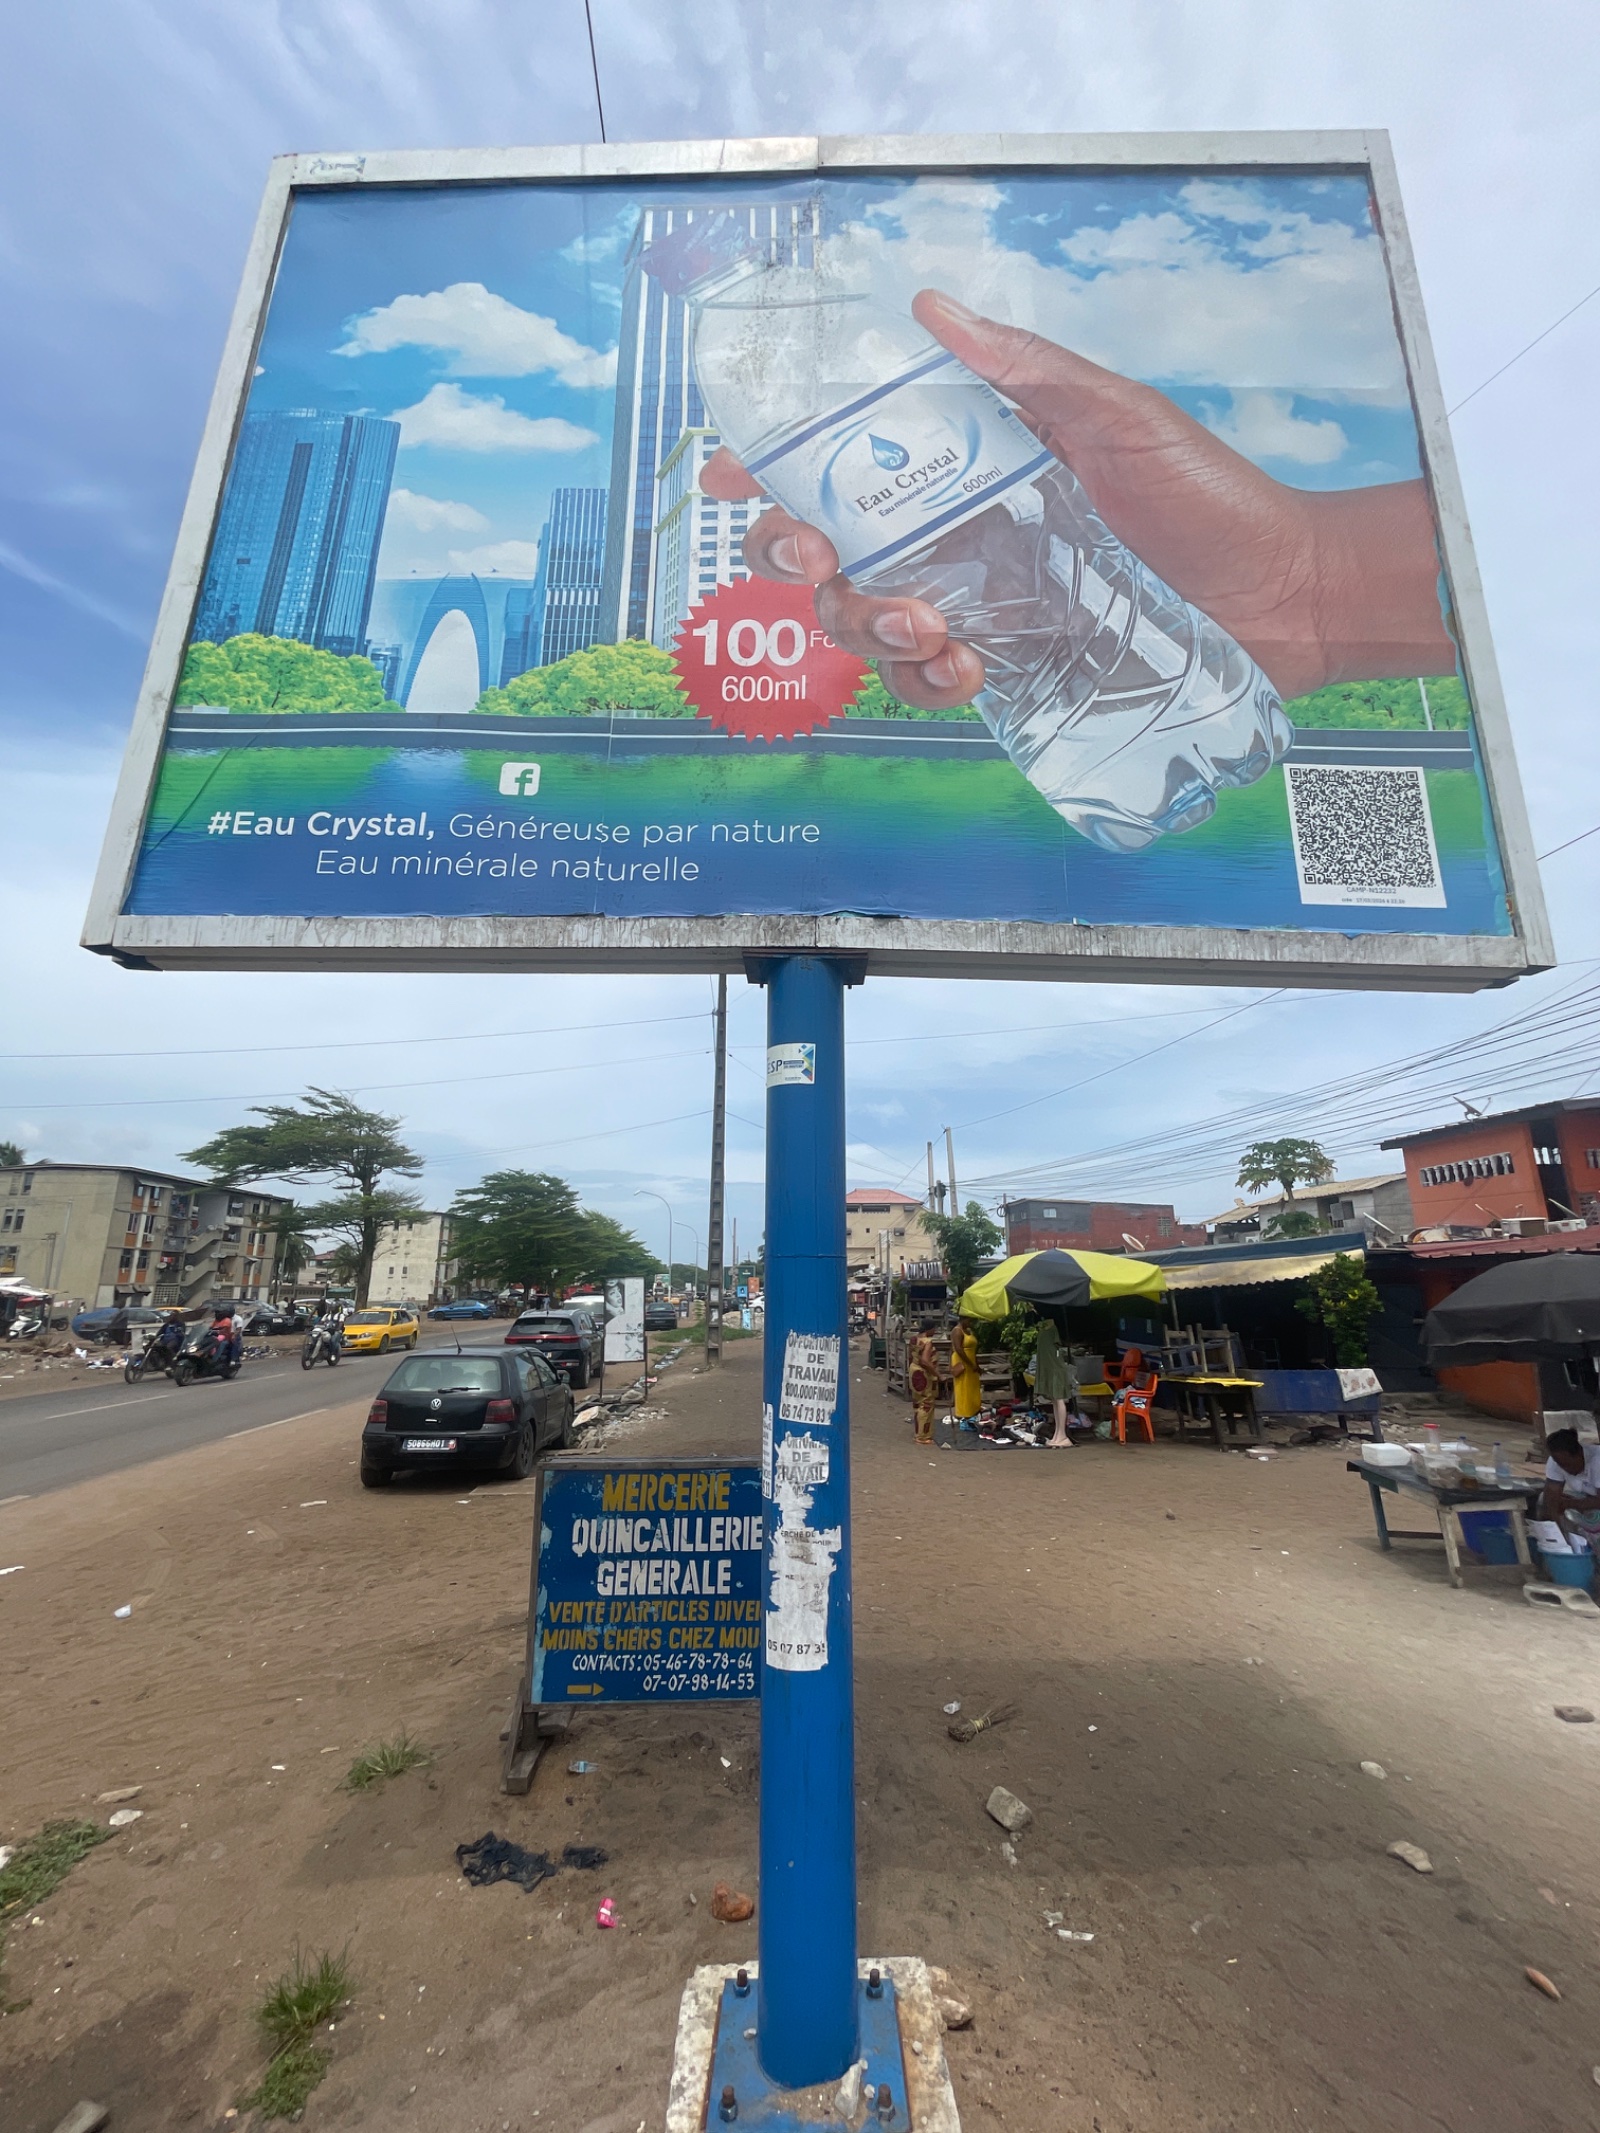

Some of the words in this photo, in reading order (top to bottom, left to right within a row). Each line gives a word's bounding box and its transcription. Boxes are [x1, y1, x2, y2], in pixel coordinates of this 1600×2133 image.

[854, 487, 895, 513] Eau
[894, 447, 961, 489] Crystal
[878, 505, 896, 517] Eau
[894, 485, 927, 509] minérale
[925, 467, 959, 490] naturelle
[962, 466, 1003, 493] 600ml
[692, 618, 807, 667] 100
[721, 675, 807, 702] 600ml
[207, 811, 295, 836] #Eau
[307, 811, 435, 841] Crystal,
[450, 813, 631, 844] Généreuse
[643, 822, 699, 848] par
[711, 819, 820, 843] nature
[316, 850, 379, 875] Eau
[390, 850, 539, 878] minérale
[551, 855, 700, 882] naturelle
[807, 1352, 826, 1365] DE
[787, 1364, 837, 1384] TRAVAIL
[781, 1403, 792, 1418] 05
[804, 1406, 815, 1422] 73
[816, 1408, 826, 1423] 83
[792, 1451, 811, 1463] DE
[602, 1473, 731, 1512] MERCERIE
[571, 1514, 763, 1557] QUINCAILLERIE
[597, 1559, 732, 1596] GENERALE
[549, 1601, 606, 1623] VENTE
[609, 1600, 709, 1623] D'ARTICLES
[542, 1628, 599, 1651] MOINS
[604, 1627, 662, 1650] CHERS
[668, 1627, 714, 1649] CHEZ
[719, 1626, 761, 1649] MOU
[767, 1639, 778, 1652] 05
[796, 1643, 811, 1655] 87
[642, 1673, 755, 1692] 07-07-98-14-53
